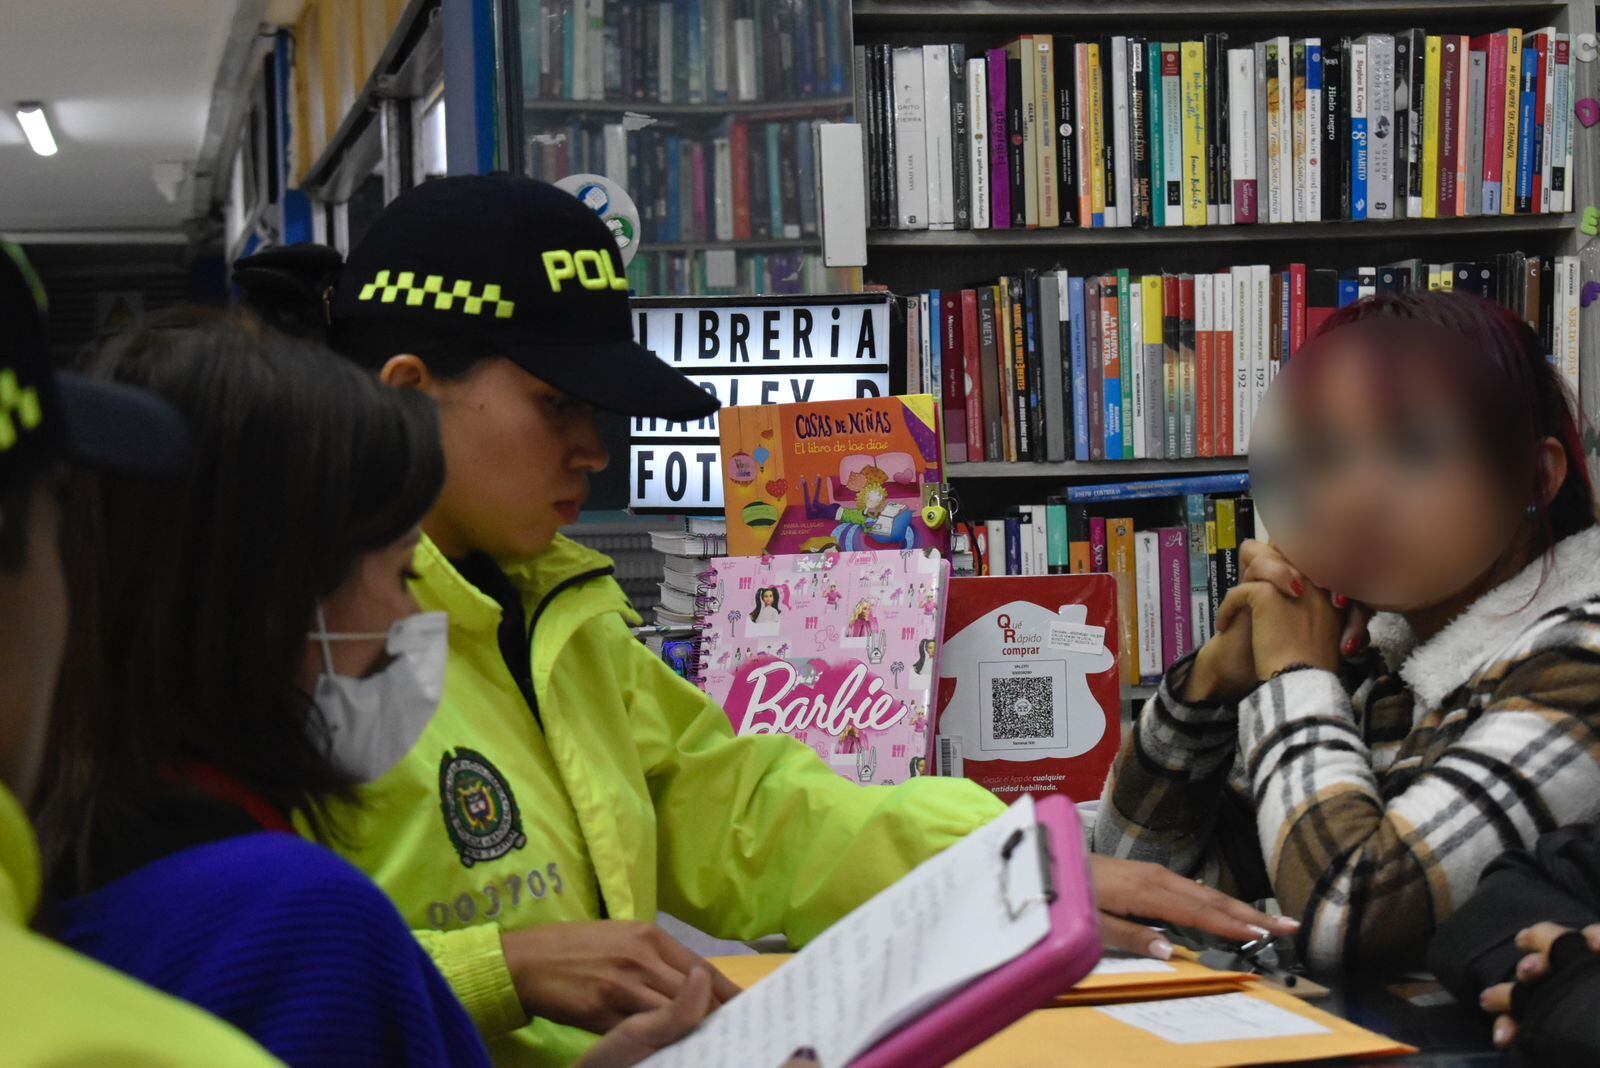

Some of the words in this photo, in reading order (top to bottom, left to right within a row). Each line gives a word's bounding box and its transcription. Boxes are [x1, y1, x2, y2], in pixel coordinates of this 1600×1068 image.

[1328, 86, 1337, 111] Hielo
[1328, 114, 1336, 140] negro
[982, 308, 990, 320] LA
[1110, 317, 1117, 327] LA
[983, 322, 992, 346] META
[1110, 329, 1118, 359] NUEVA
[1103, 338, 1111, 366] EXTRA
[1238, 368, 1246, 388] 192
[1256, 367, 1264, 388] 192
[795, 413, 832, 439] COSAS
[835, 420, 847, 434] DE
[808, 441, 832, 454] libro
[833, 441, 846, 452] de
[848, 439, 865, 451] los
[1172, 559, 1183, 613] sentimiento
[1004, 629, 1042, 644] Rápido
[1002, 645, 1040, 658] comprar
[738, 661, 908, 737] Barbie
[991, 785, 1019, 793] entidad
[1019, 783, 1058, 792] habilitada.
[1010, 775, 1023, 784] App
[1032, 774, 1066, 783] cualquier
